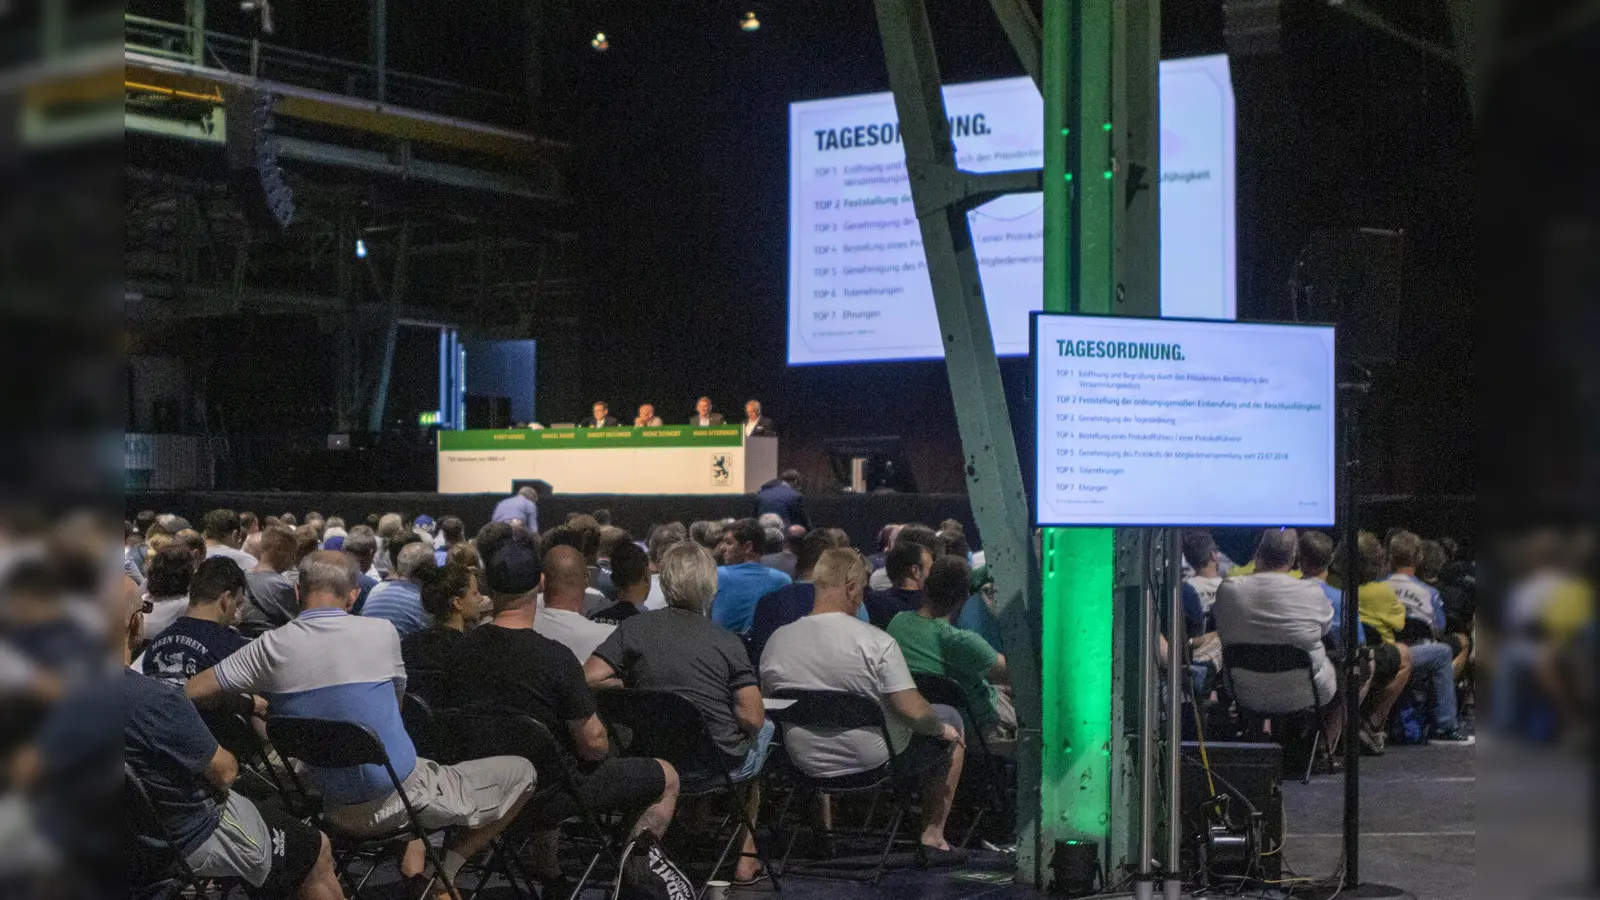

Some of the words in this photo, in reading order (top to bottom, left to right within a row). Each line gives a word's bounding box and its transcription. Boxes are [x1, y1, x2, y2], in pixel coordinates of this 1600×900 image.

[814, 200, 834, 210] TOP
[844, 195, 899, 208] Feststellung
[1056, 340, 1186, 360] TAGESORDNUNG.
[1056, 396, 1072, 404] TOP
[1072, 396, 1077, 404] 2
[1079, 396, 1120, 406] Feststellung
[1198, 400, 1238, 409] Einberufung
[175, 634, 208, 656] VEREIN
